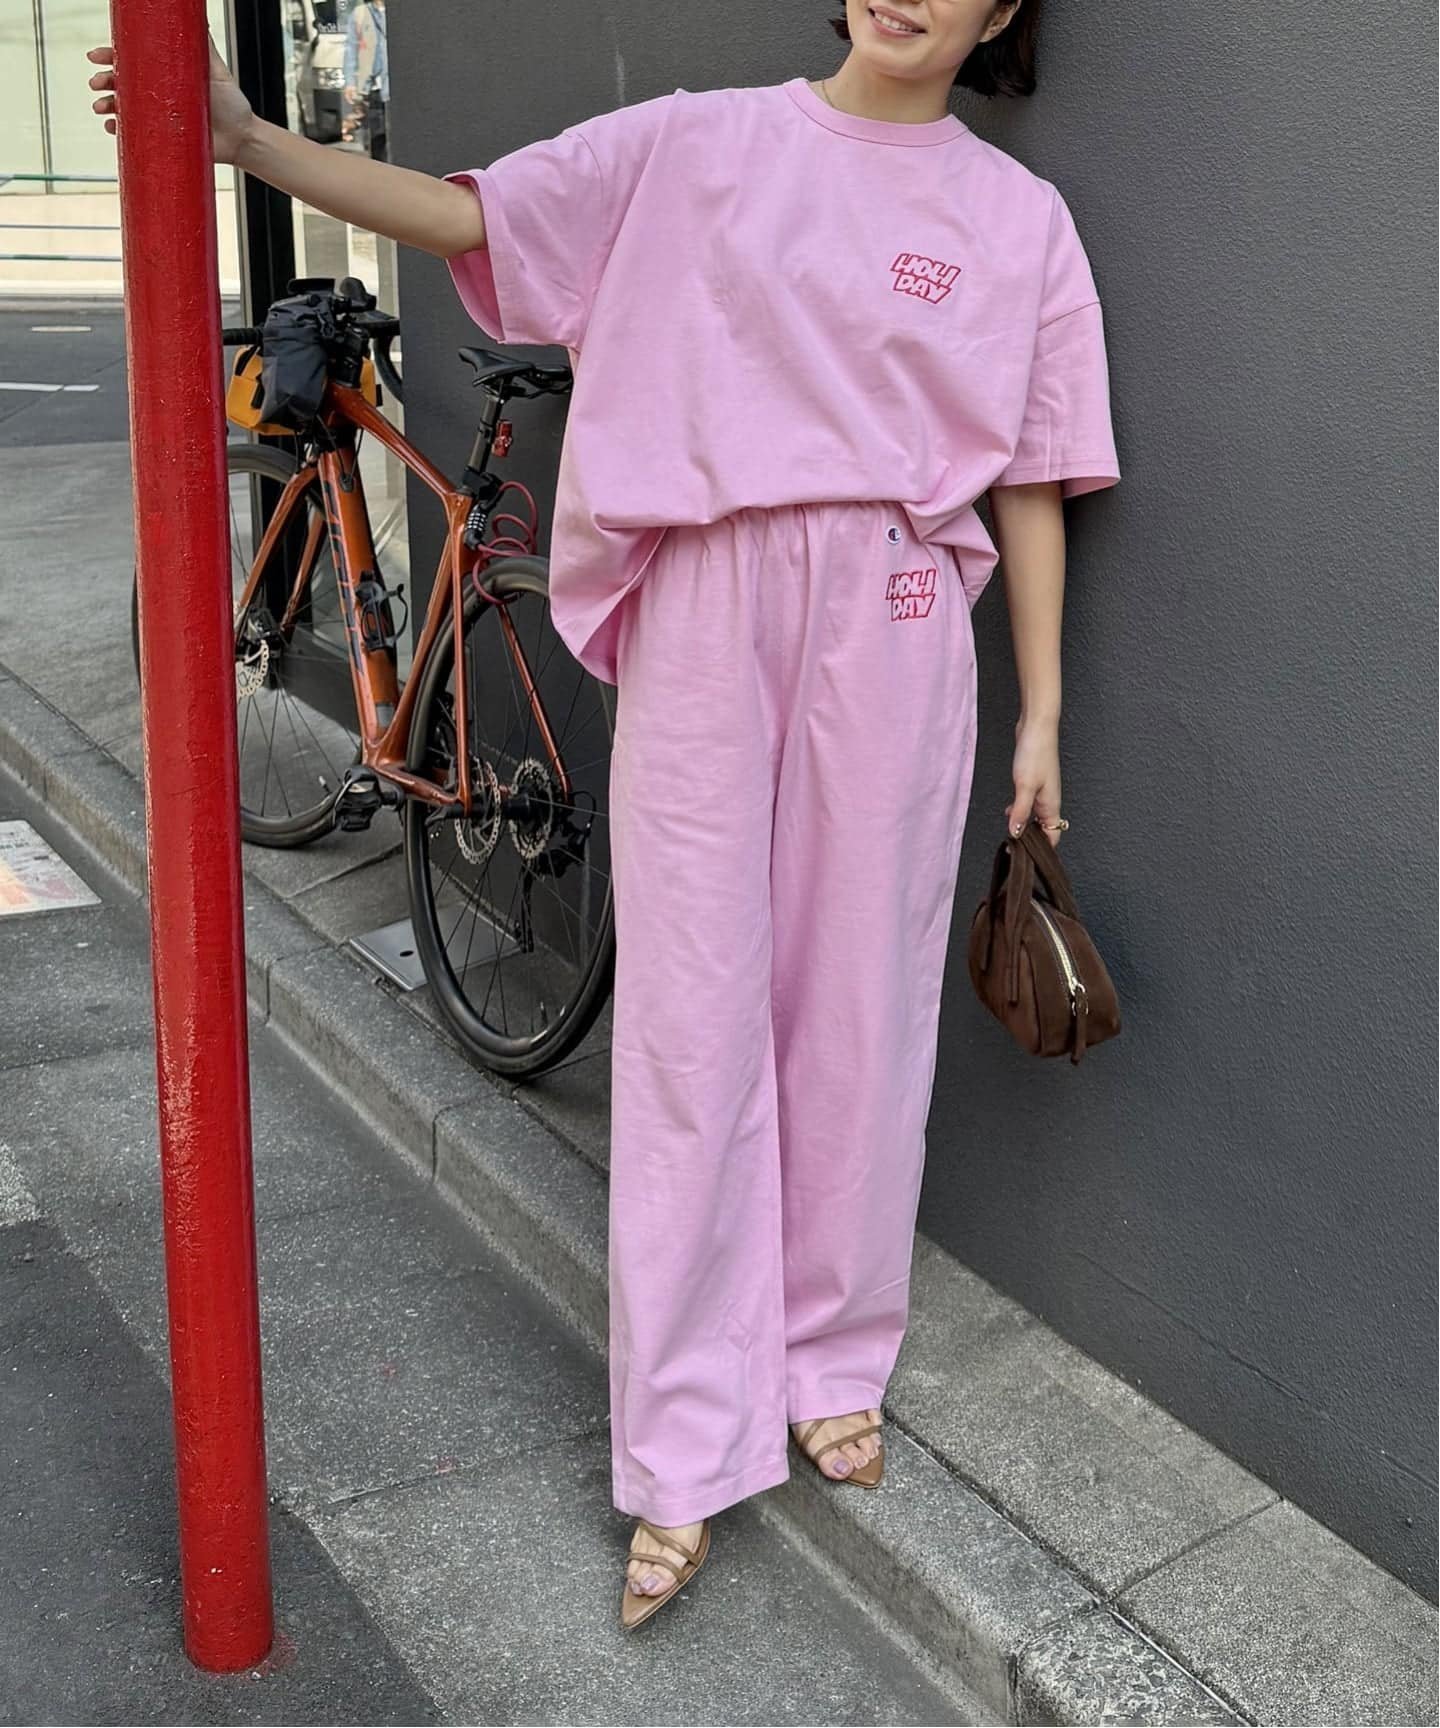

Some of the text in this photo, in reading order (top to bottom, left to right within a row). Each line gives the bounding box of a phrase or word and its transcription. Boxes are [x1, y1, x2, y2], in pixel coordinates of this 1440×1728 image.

[890, 253, 961, 288] HOLI
[893, 271, 952, 304] DAY
[886, 568, 937, 600] HOLI
[891, 594, 936, 621] DAY
